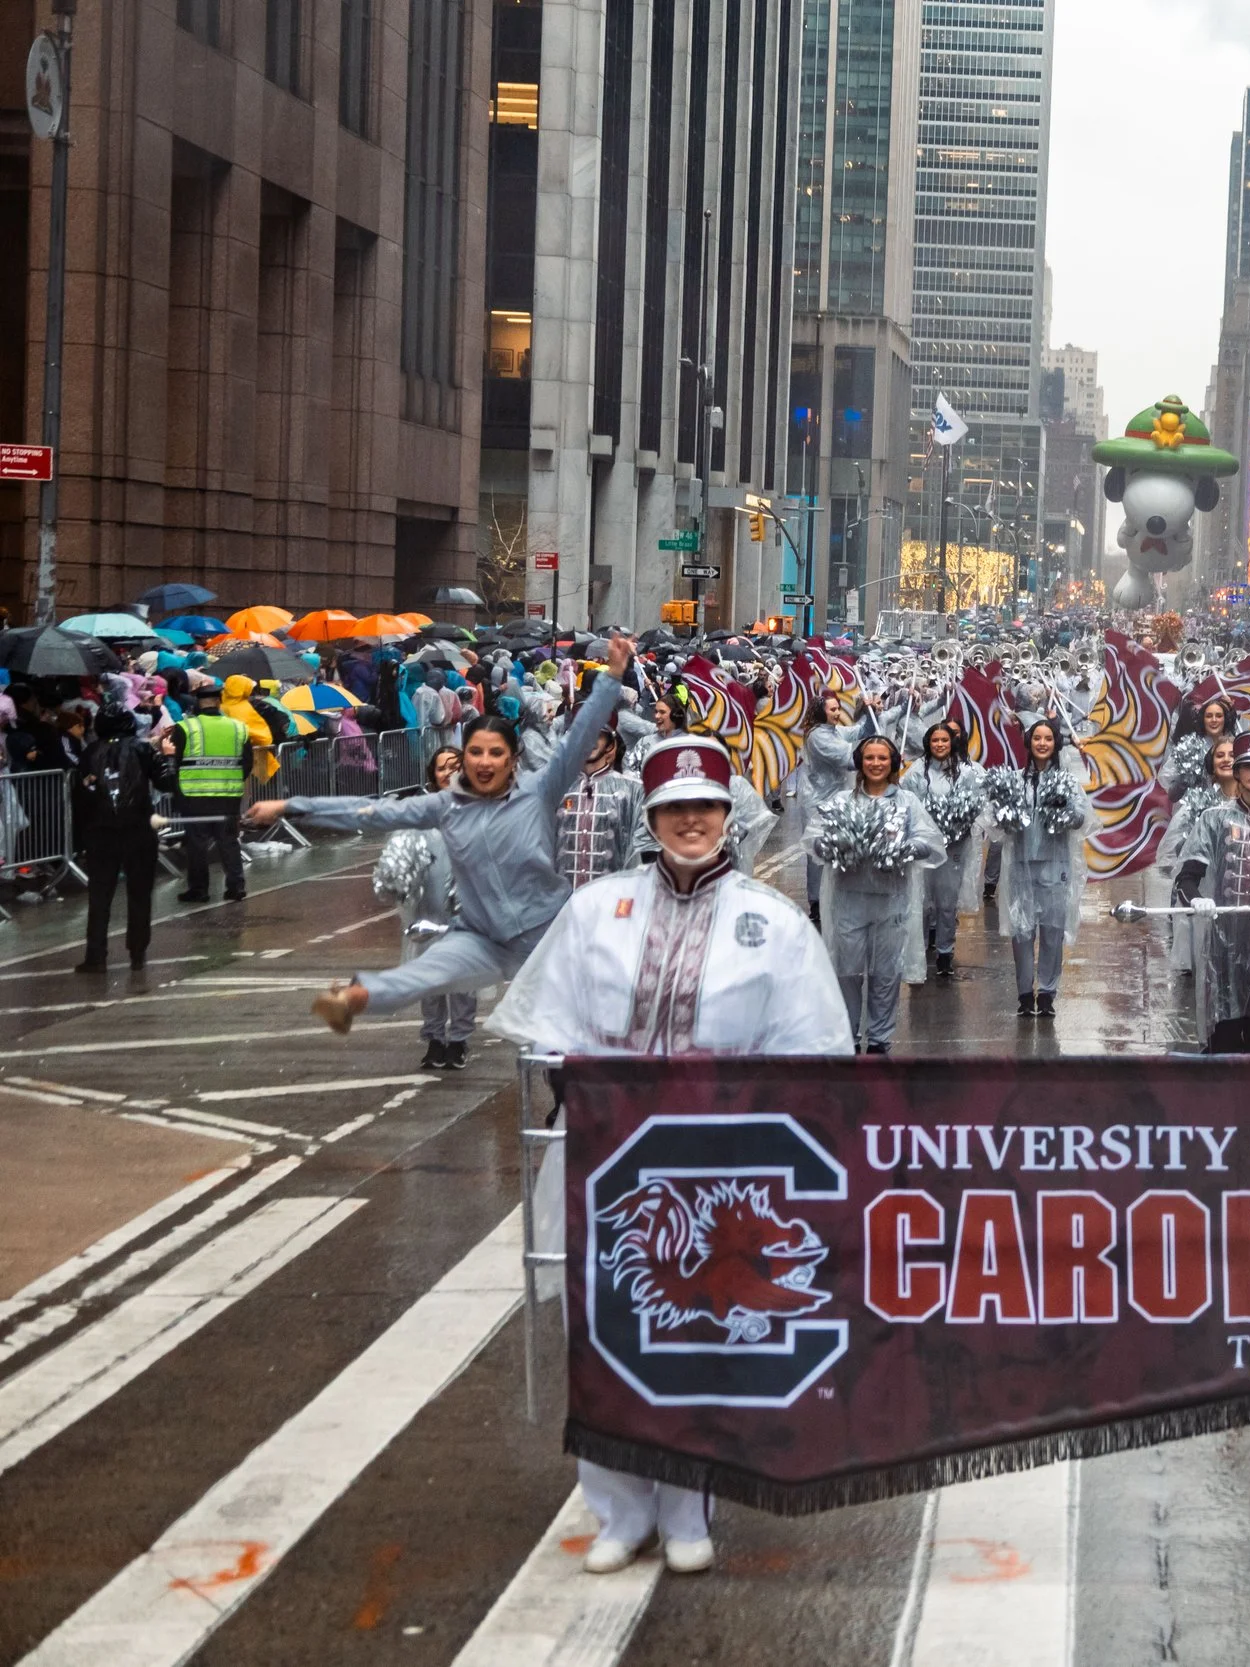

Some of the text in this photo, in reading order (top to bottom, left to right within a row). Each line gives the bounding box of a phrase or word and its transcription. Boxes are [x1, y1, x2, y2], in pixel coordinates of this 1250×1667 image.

[935, 411, 953, 434] OX
[12, 449, 43, 457] STOPPING
[862, 1124, 1237, 1171] UNIVERSITY
[817, 1386, 835, 1399] TM
